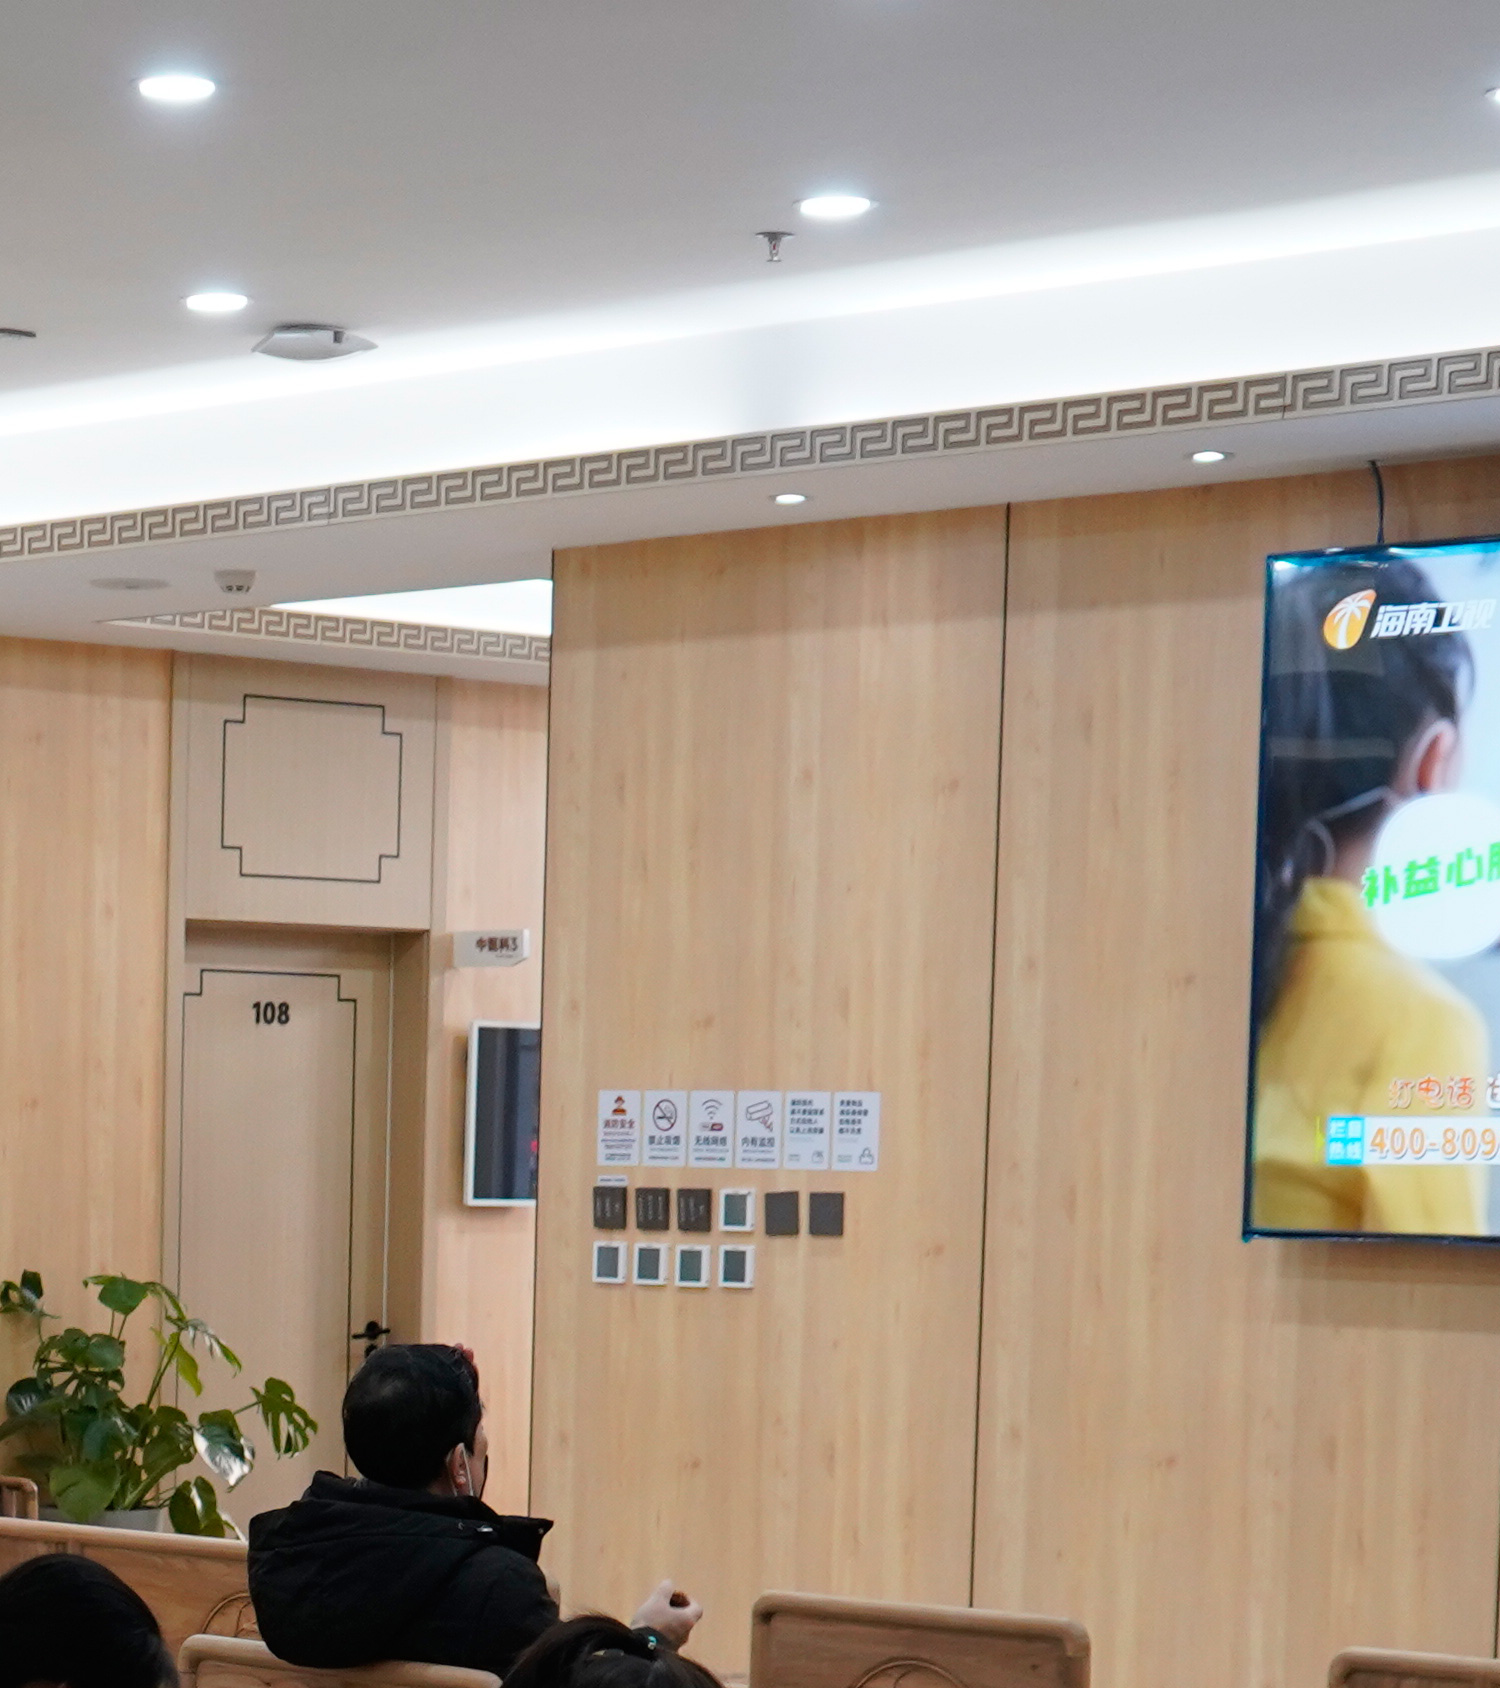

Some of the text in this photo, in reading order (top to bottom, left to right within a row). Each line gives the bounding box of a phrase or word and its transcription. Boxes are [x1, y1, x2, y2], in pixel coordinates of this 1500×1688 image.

[1370, 598, 1497, 639] 海南卫视
[252, 1001, 290, 1025] 108
[1388, 1075, 1475, 1109] 打电话
